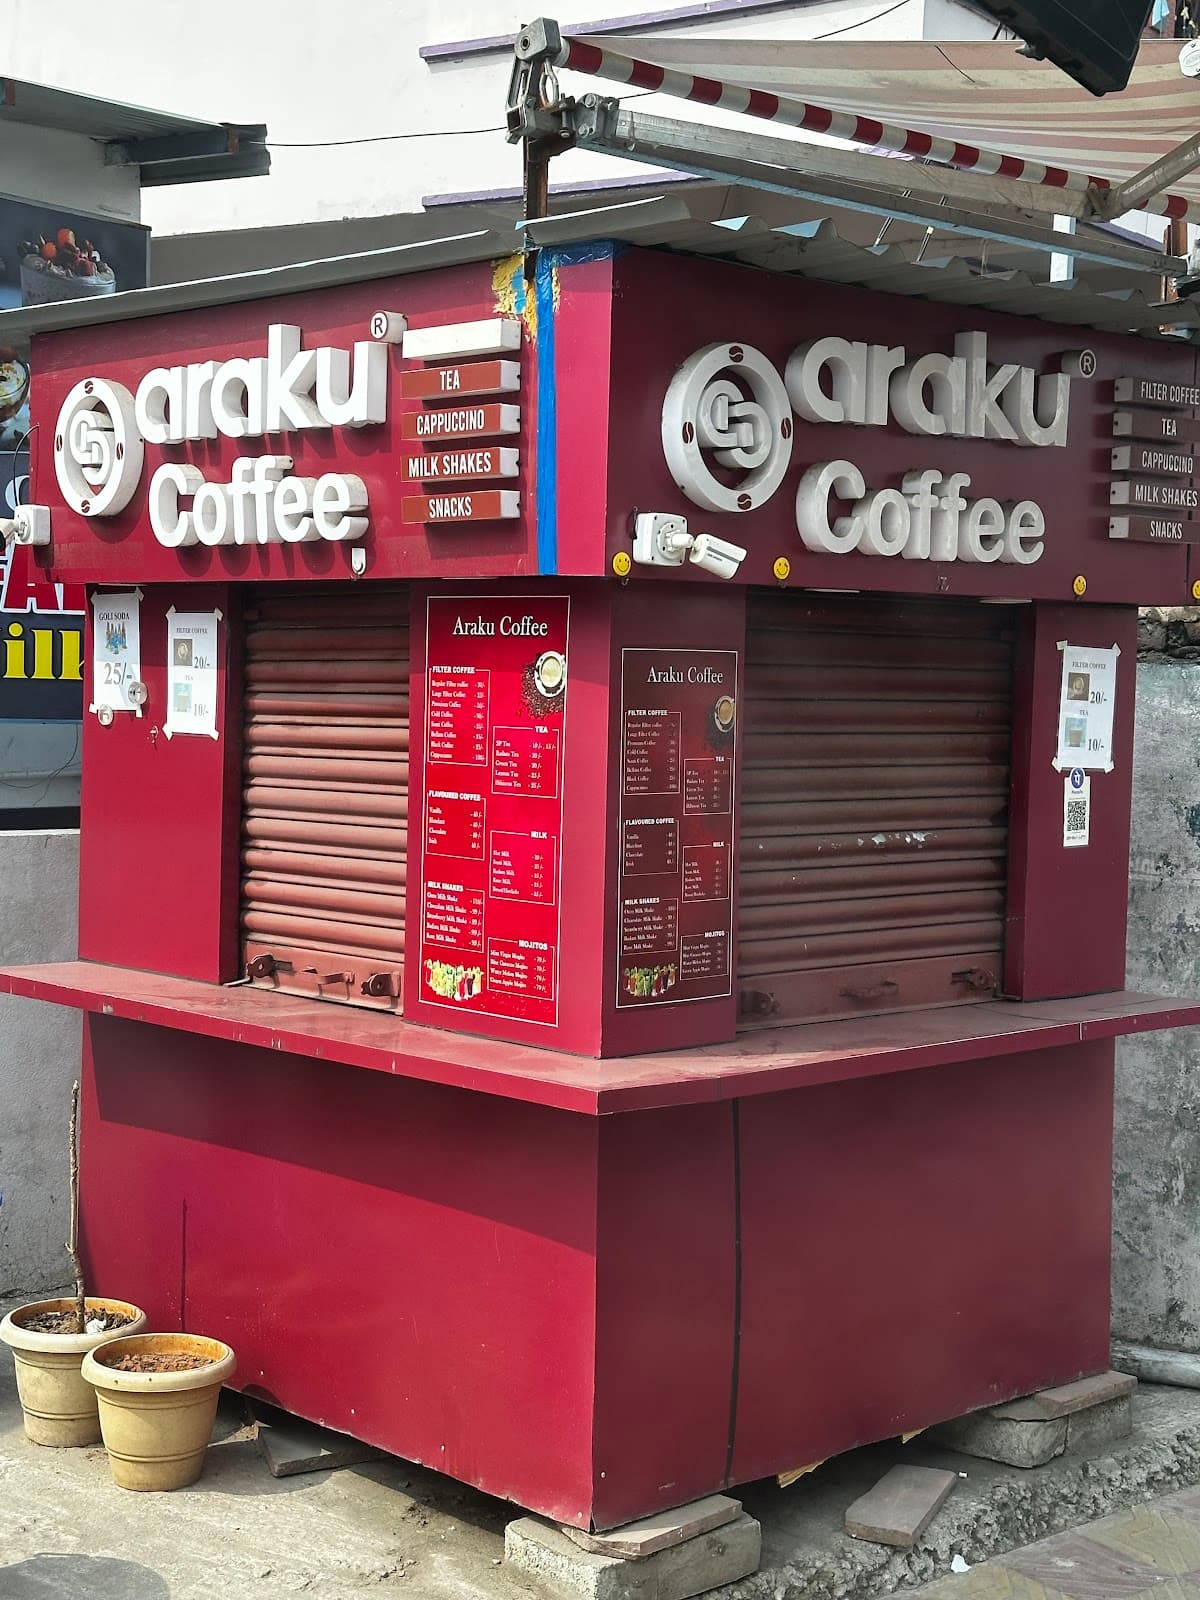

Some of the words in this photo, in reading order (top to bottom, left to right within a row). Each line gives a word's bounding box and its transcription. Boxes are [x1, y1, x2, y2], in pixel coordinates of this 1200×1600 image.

[135, 324, 386, 444] araku
[440, 370, 460, 390] TEA
[784, 330, 1070, 447] araku
[1141, 382, 1167, 401] FILTER
[1170, 385, 1200, 405] COFFEE
[416, 410, 484, 434] CAPPUCCINO
[1162, 418, 1176, 436] TEA
[409, 456, 439, 477] MILK
[443, 452, 492, 474] SHAKES
[1142, 451, 1193, 474] CAPPUCCINO
[149, 455, 369, 547] Coffee
[1136, 484, 1159, 503] MILK
[1162, 488, 1198, 506] SHAKES
[429, 496, 472, 518] SNACKS
[796, 460, 1045, 564] Coffee
[1150, 520, 1182, 539] SNACKS
[99, 612, 114, 620] GOLI
[114, 612, 130, 620] SODA
[452, 616, 495, 635] Araku
[500, 616, 548, 636] Coffee
[647, 666, 684, 683] Araku
[687, 666, 724, 683] Coffee
[1090, 692, 1107, 704] 20/-
[1088, 739, 1104, 751] 10/-
[519, 940, 548, 950] MOJITOS
